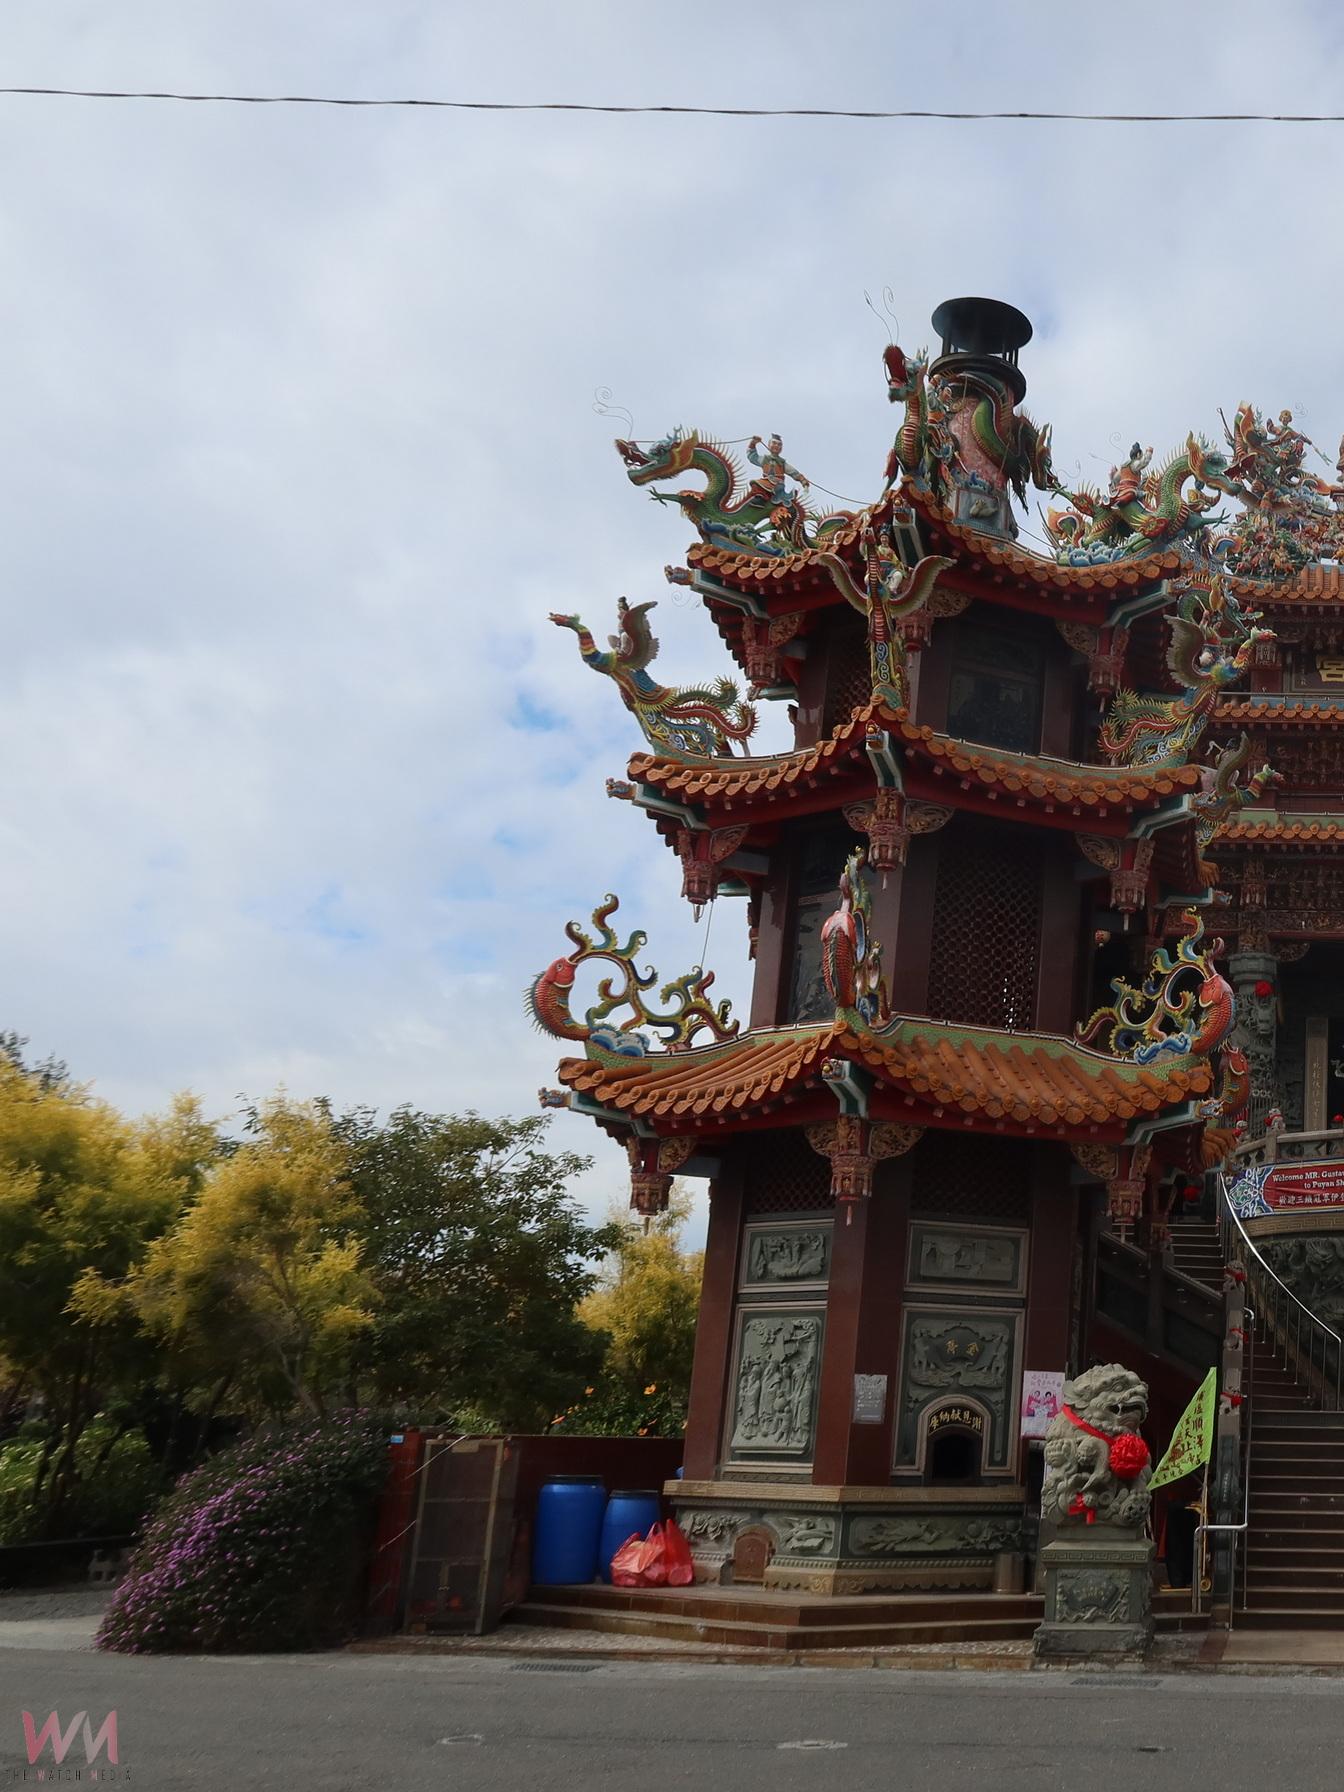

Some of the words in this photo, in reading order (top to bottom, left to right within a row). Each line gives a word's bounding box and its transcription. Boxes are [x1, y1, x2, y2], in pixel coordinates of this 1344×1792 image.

[1272, 1173, 1304, 1183] Welcome
[1305, 1171, 1320, 1180] MR.
[1312, 1181, 1335, 1190] Puyan
